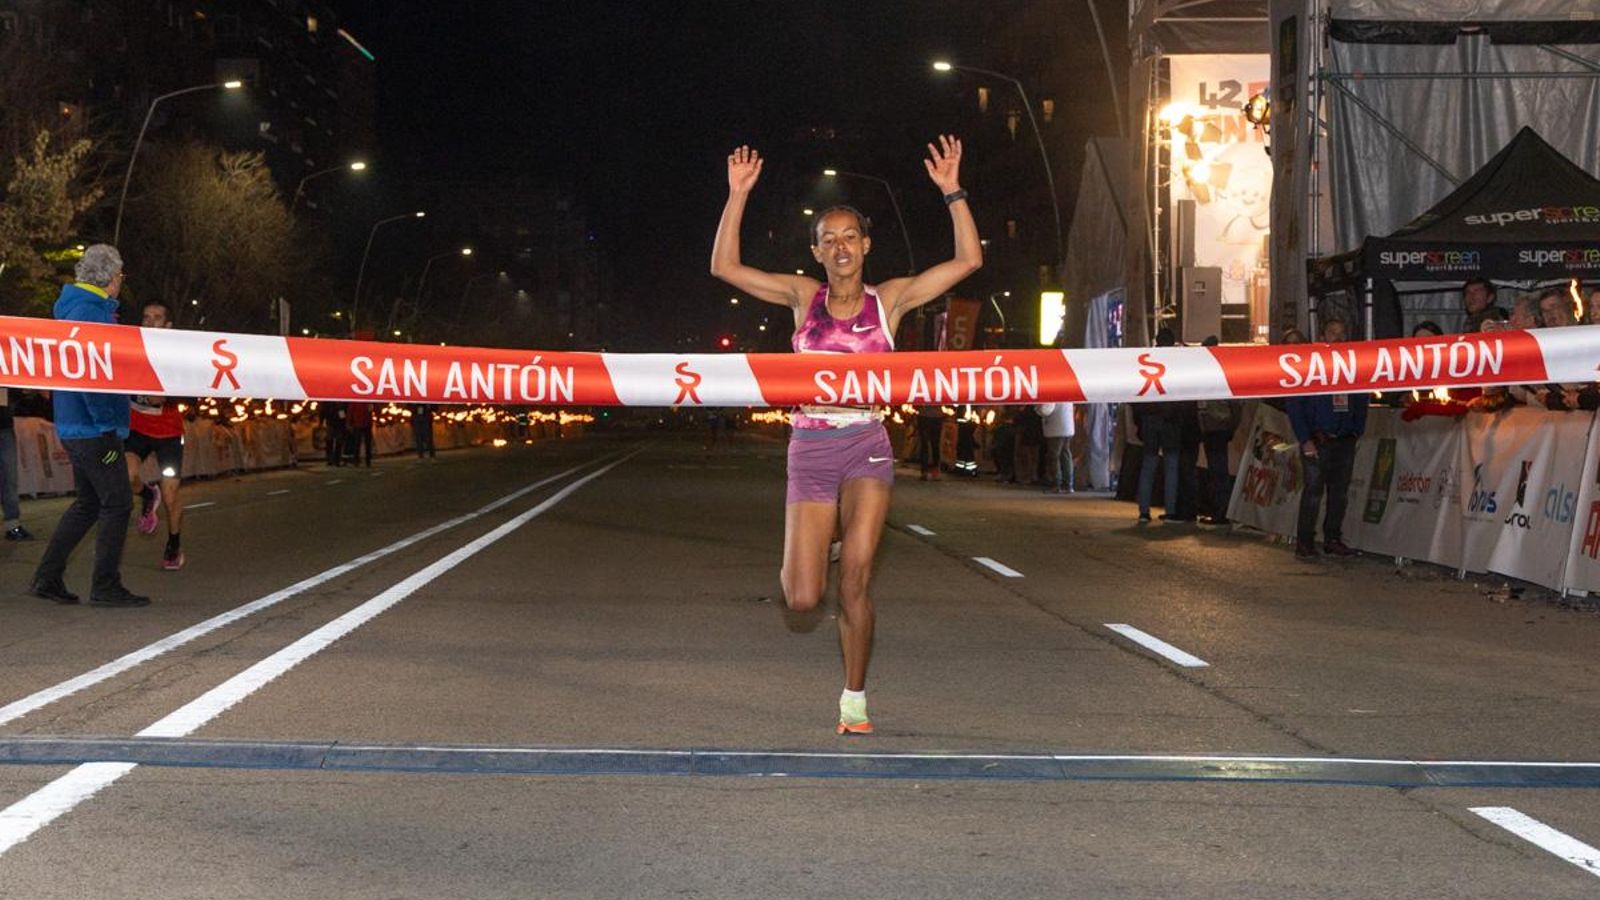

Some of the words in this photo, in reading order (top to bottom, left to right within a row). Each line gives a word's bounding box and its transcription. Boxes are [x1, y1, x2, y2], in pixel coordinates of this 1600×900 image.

[1380, 250, 1480, 268] superscreen
[350, 356, 428, 398] SAN
[443, 355, 574, 402] ANTÓN
[814, 370, 891, 404] SAN
[907, 355, 1038, 402] ANTÓN
[1279, 349, 1357, 388] SAN
[1370, 336, 1503, 382] ANTÓN
